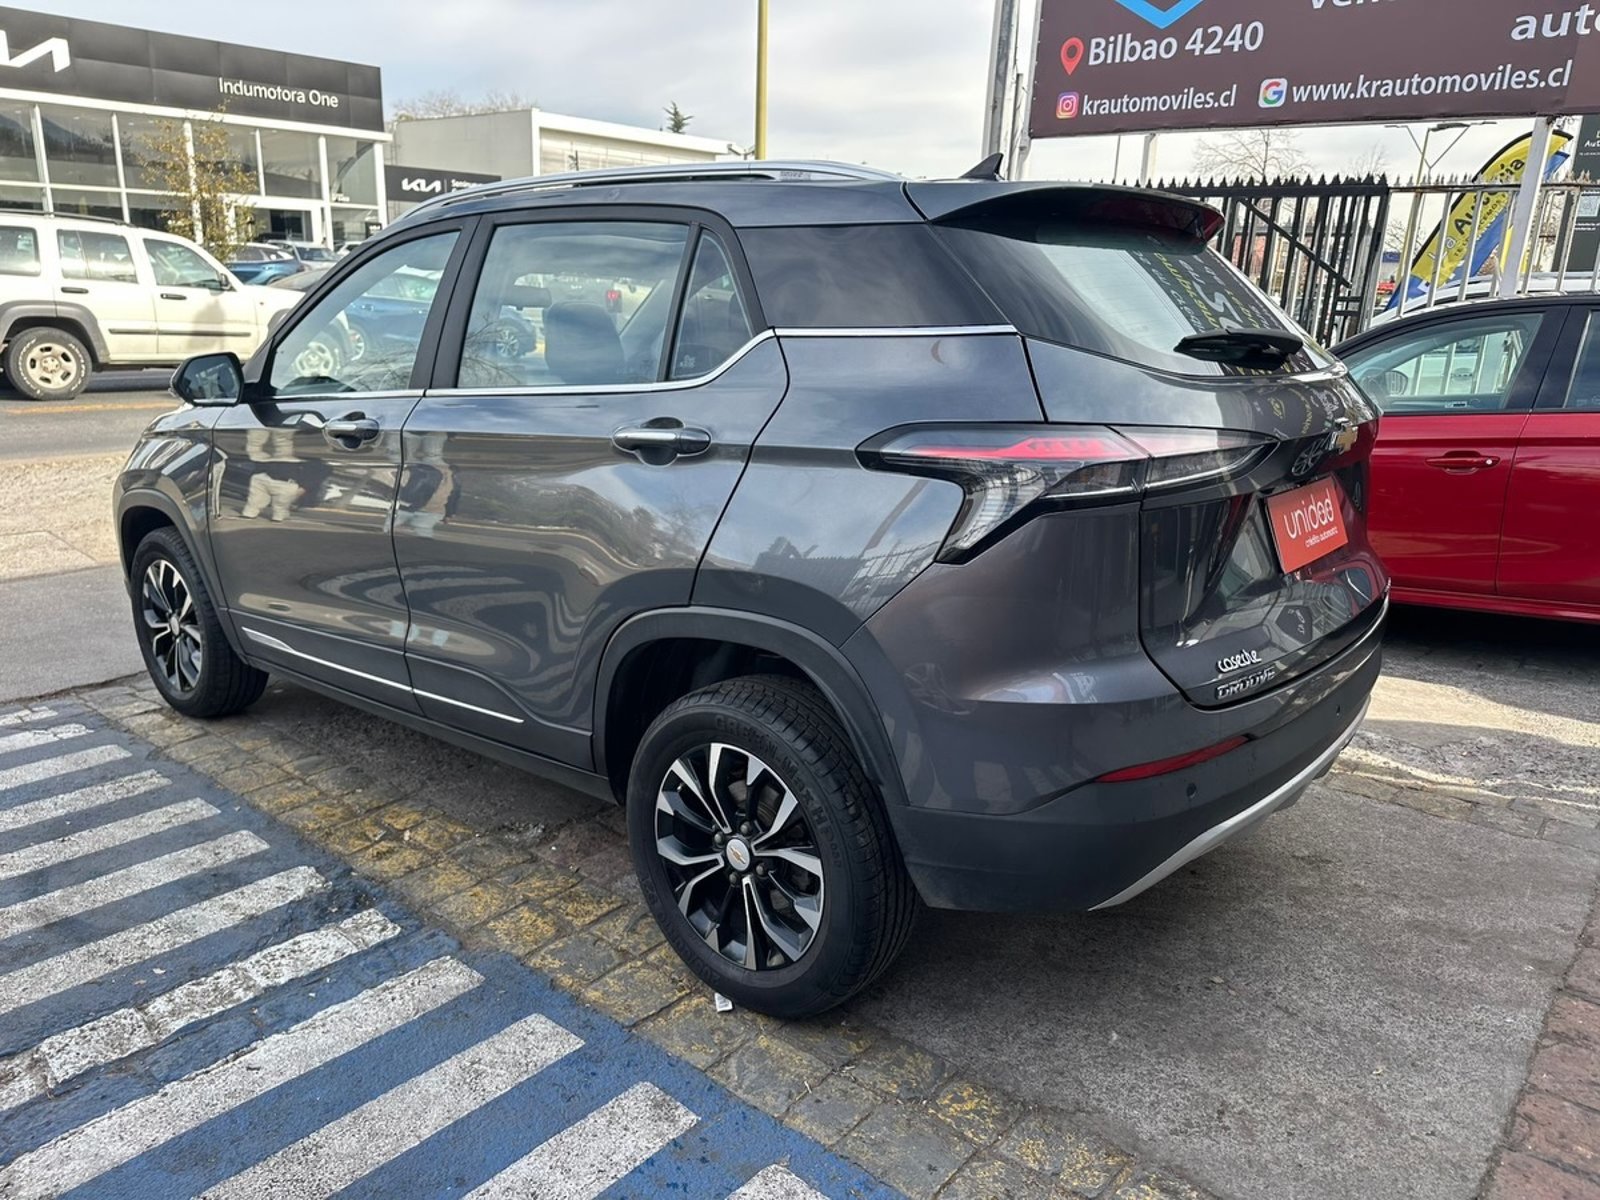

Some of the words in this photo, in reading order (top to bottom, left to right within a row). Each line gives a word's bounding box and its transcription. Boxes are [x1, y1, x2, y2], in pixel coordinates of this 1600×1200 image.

[1510, 4, 1600, 41] aut
[1088, 33, 1177, 66] Bilbao
[1184, 21, 1264, 56] 4240
[218, 77, 305, 105] Indumotora
[308, 89, 339, 108] One
[1082, 84, 1237, 116] krautomoviles.cl
[1292, 59, 1573, 102] www.krautomoviles.cl
[1283, 487, 1335, 540] unidad
